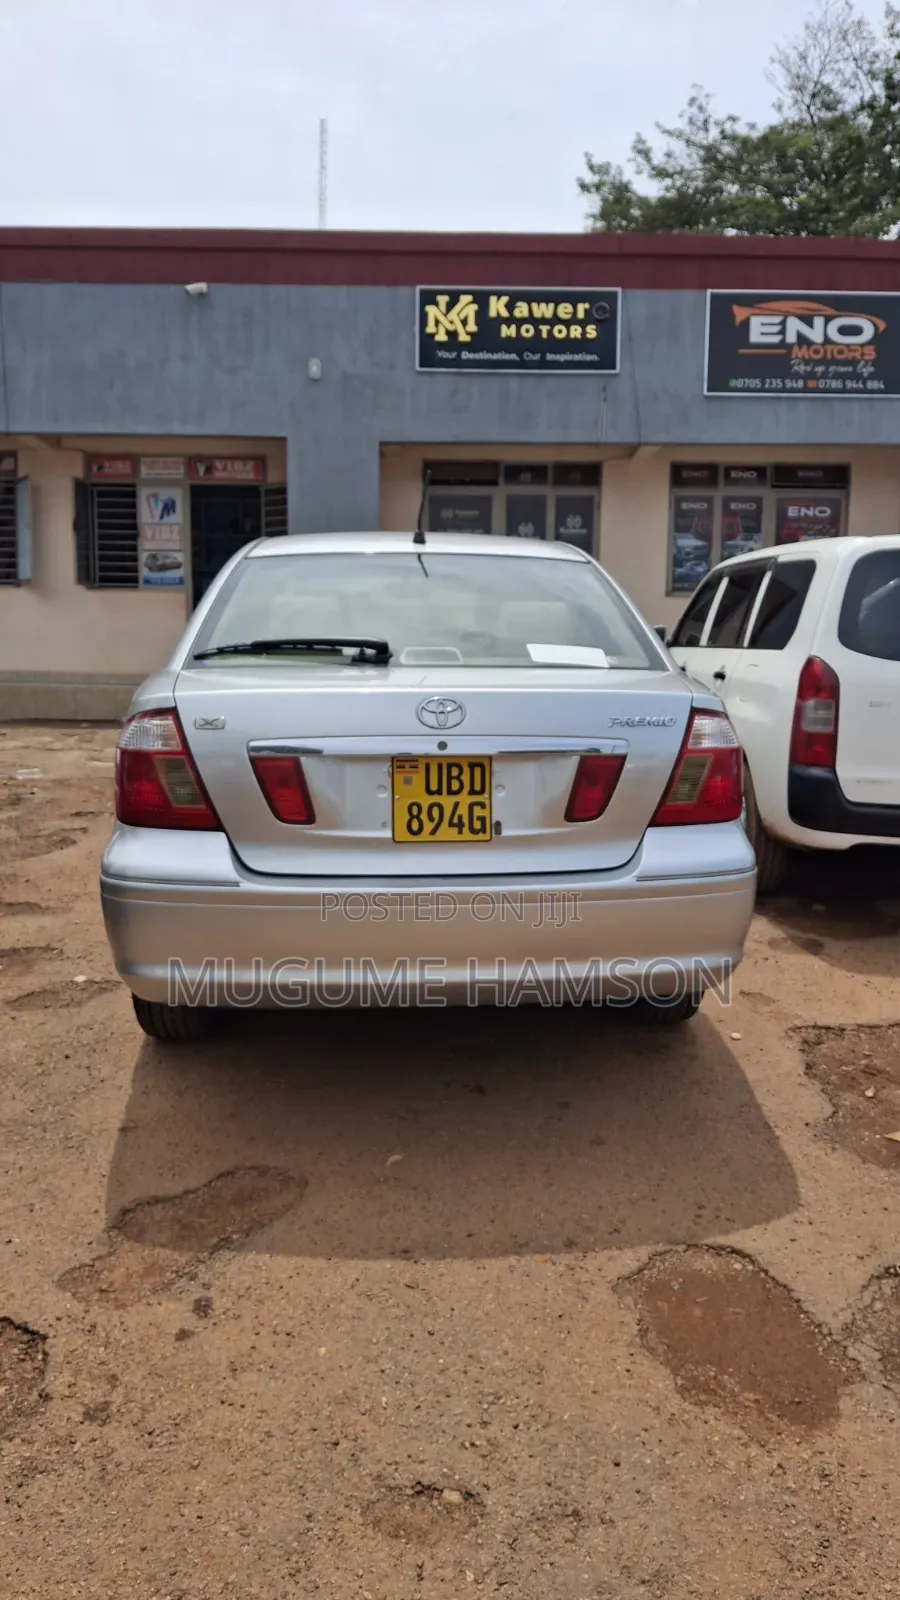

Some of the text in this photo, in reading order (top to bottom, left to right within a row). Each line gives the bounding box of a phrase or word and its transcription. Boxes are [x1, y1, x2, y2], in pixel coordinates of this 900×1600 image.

[500, 323, 598, 339] MOTORS
[749, 315, 875, 345] ENO
[436, 349, 600, 362] Your Destination, Our Inspiration.
[791, 344, 877, 361] MOTORS
[764, 378, 783, 388] 235
[730, 470, 757, 479] ENO
[681, 502, 708, 510] ENO
[730, 502, 756, 510] ENO
[787, 506, 831, 517] ENO
[607, 716, 676, 728] PREMIO
[425, 762, 486, 796] UBD
[406, 801, 487, 836] 894G
